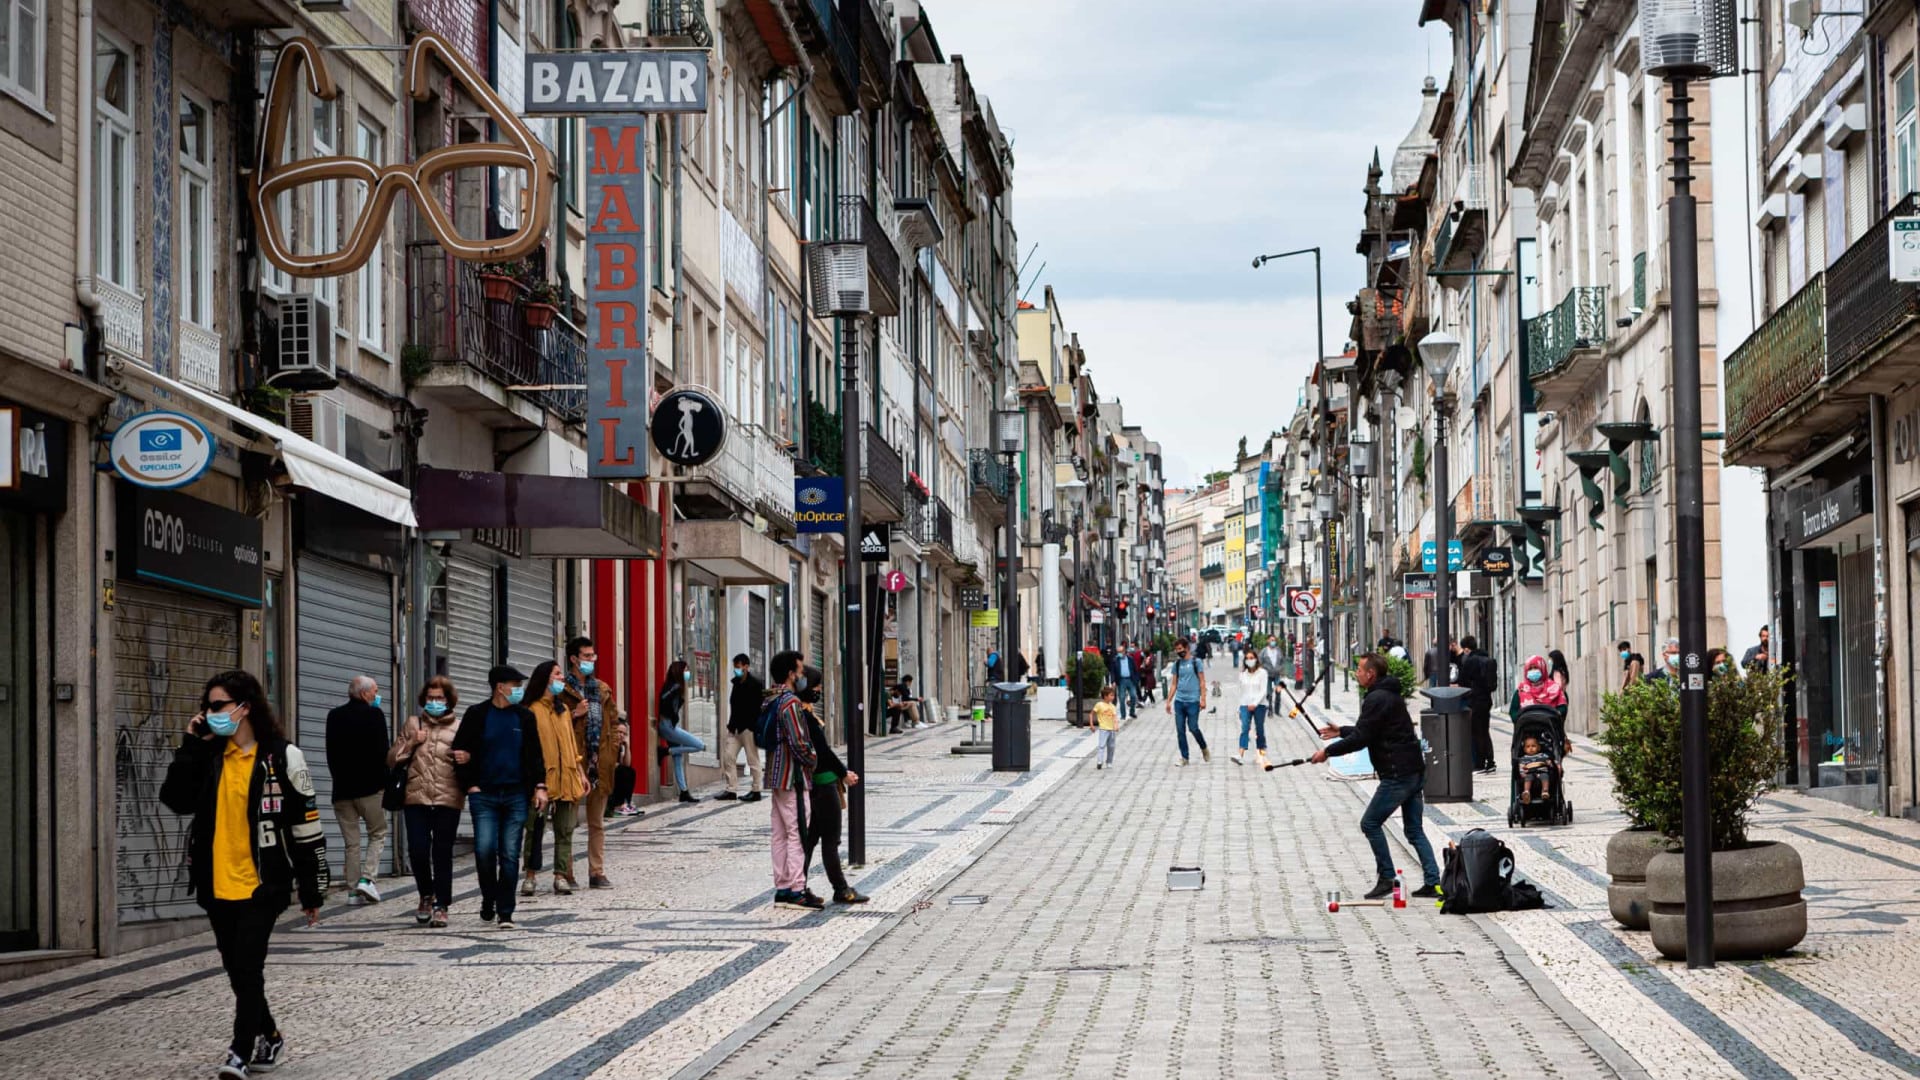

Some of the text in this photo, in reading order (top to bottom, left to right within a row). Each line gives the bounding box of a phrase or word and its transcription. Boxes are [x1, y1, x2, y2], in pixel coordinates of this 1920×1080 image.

[532, 61, 698, 103] BAZAR
[589, 126, 642, 466] MABRIL
[140, 463, 182, 472] ESPECIALISTA
[1803, 498, 1840, 537] Branca de Neve
[186, 533, 223, 554] OCULISTA
[861, 545, 887, 553] didas
[259, 821, 276, 847] 6
